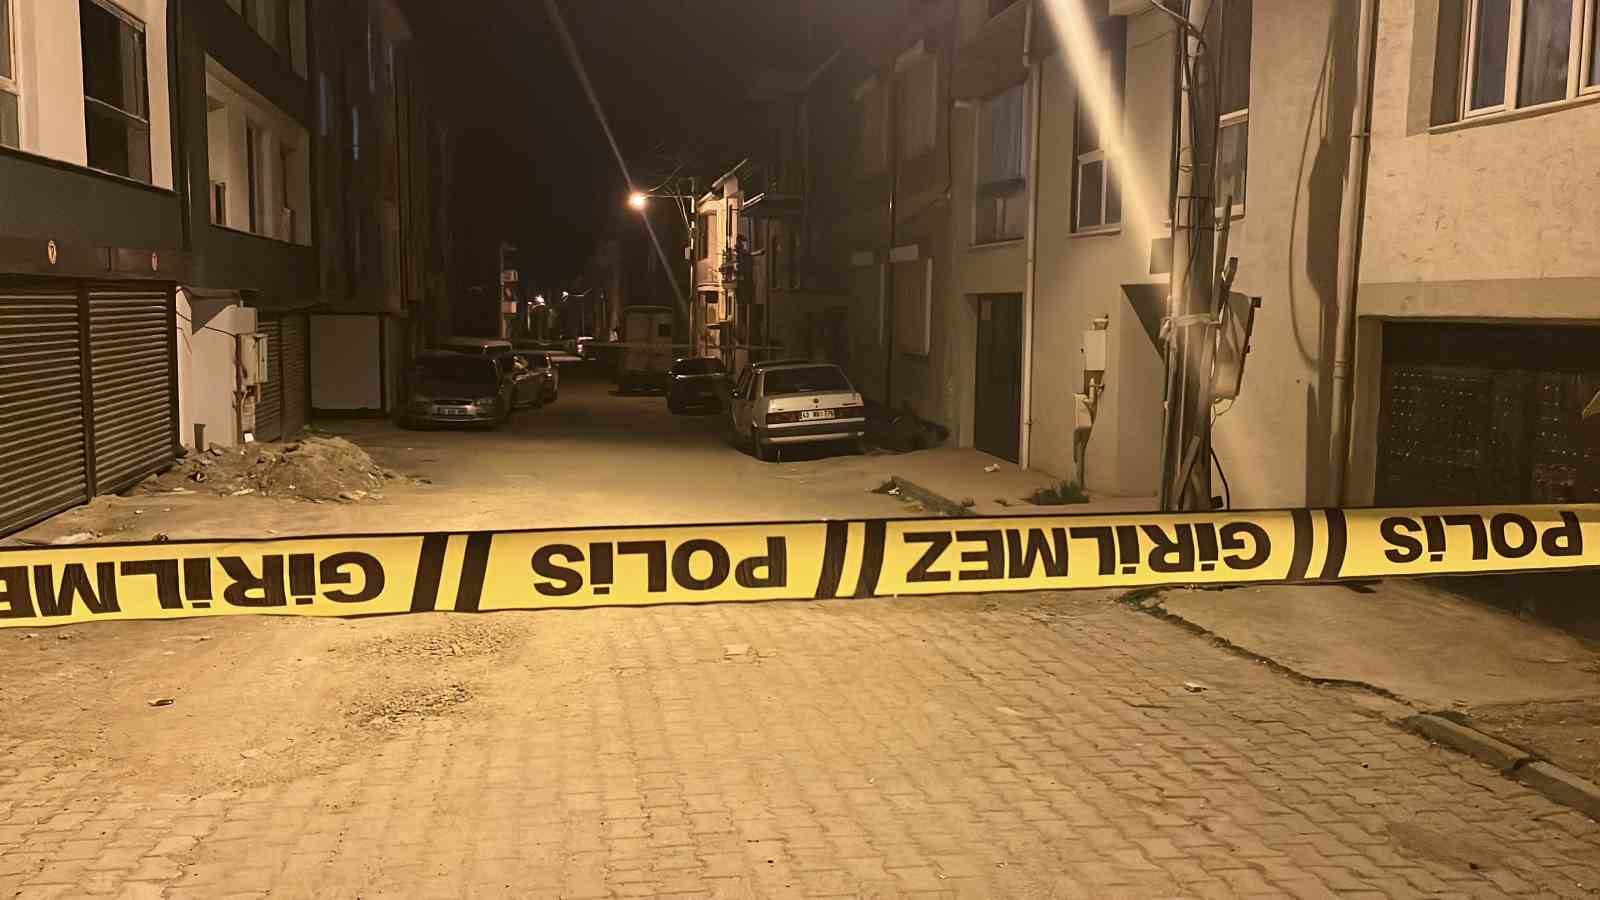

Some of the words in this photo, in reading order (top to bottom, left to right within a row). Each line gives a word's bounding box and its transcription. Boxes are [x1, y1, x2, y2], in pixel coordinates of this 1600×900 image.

[532, 536, 787, 596] POLİS
[903, 523, 1272, 583] GİRİLMEZ
[1379, 511, 1583, 563] POLİS
